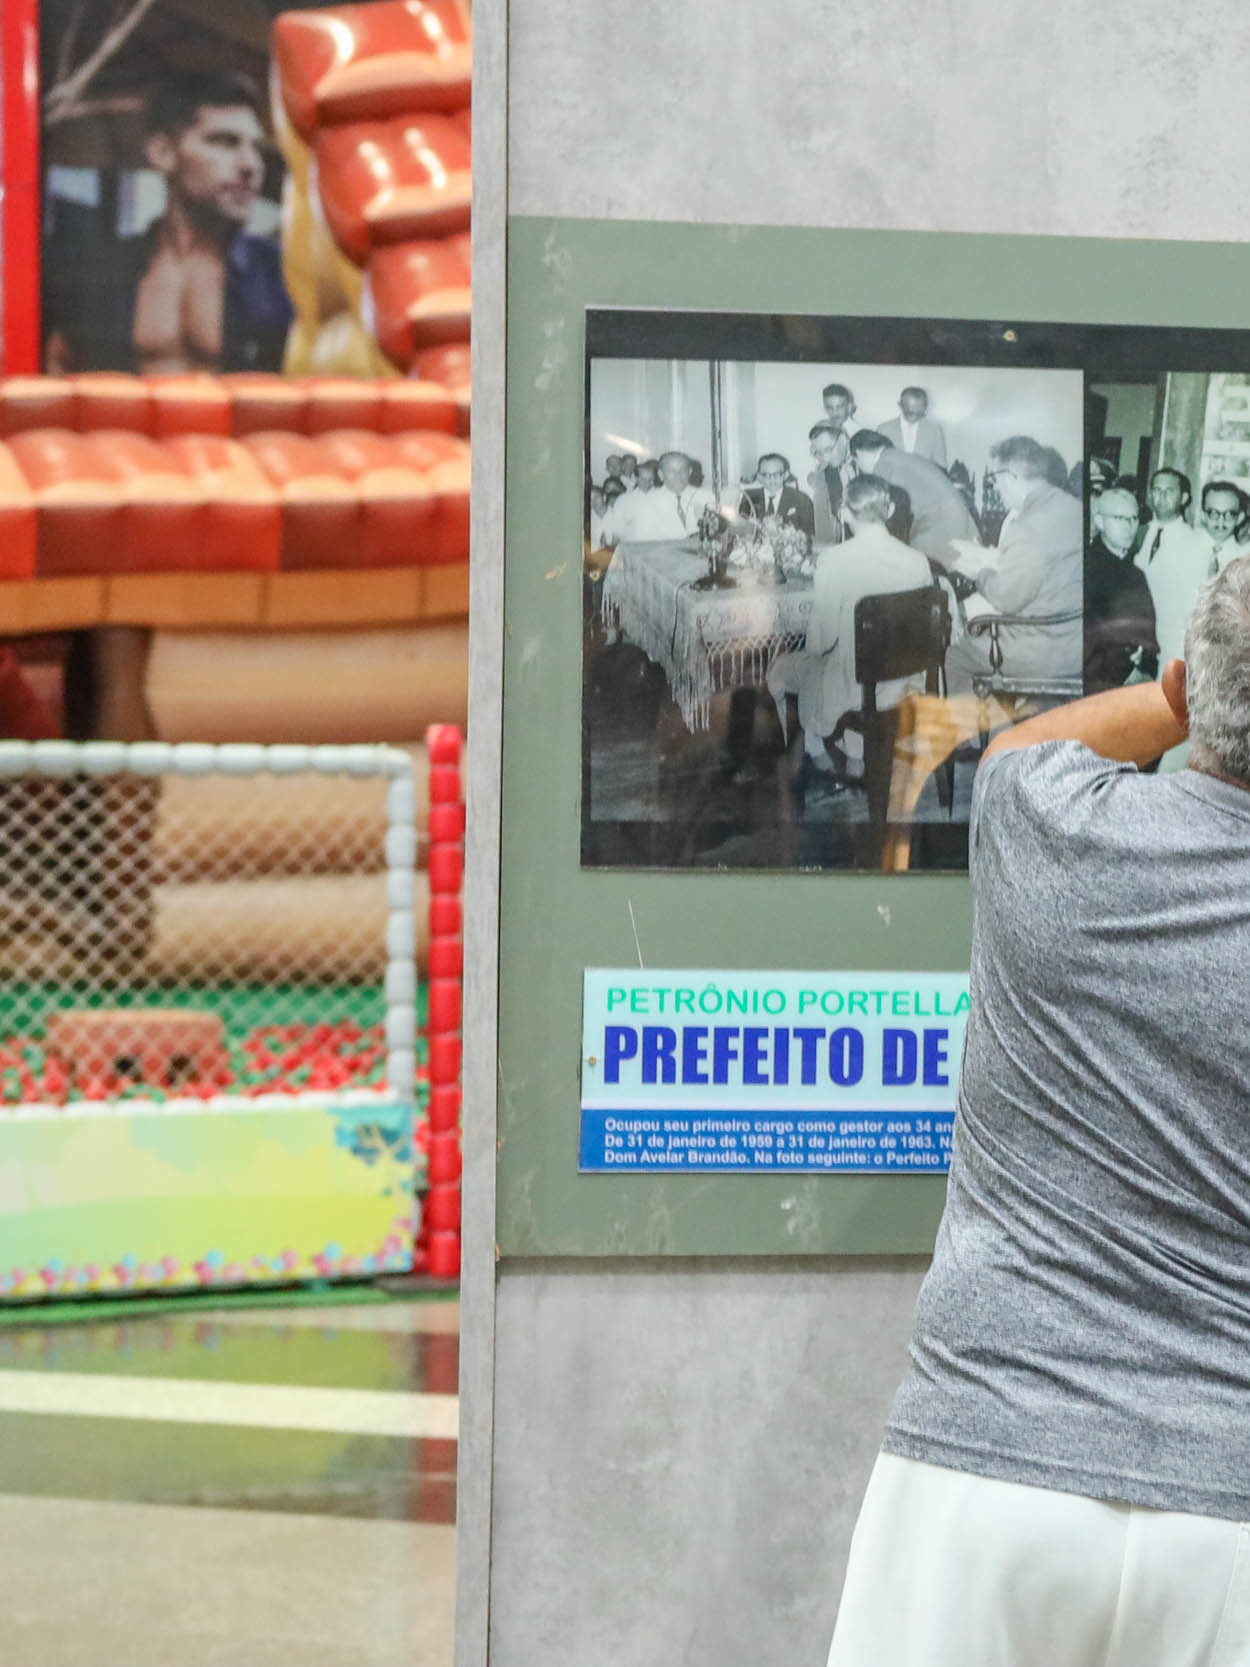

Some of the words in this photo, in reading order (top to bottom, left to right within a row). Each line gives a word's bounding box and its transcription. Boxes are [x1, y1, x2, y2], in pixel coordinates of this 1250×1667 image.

[607, 981, 787, 1015] PETRÔNIO
[798, 989, 971, 1017] PORTELLA
[604, 1025, 864, 1087] PREFEITO
[881, 1027, 949, 1087] DE
[605, 1117, 660, 1133] Ocupou
[663, 1119, 689, 1132] seu
[692, 1117, 751, 1134] primeiro
[754, 1120, 793, 1135] cargo
[797, 1121, 836, 1133] como
[839, 1119, 883, 1135] gestor
[886, 1121, 912, 1133] aos
[915, 1119, 932, 1133] 34
[935, 1121, 954, 1133] an
[605, 1134, 624, 1147] De
[627, 1134, 643, 1148] 31
[647, 1134, 665, 1148] de
[668, 1134, 716, 1150] janeiro
[719, 1135, 737, 1148] de
[776, 1138, 785, 1148] a
[788, 1135, 804, 1148] 31
[808, 1135, 825, 1148] de
[828, 1134, 876, 1150] janeiro
[879, 1135, 897, 1149] de
[901, 1136, 936, 1149] 1963.
[940, 1136, 954, 1149] N
[605, 1150, 637, 1163] Dom
[640, 1150, 684, 1163] Avelar
[688, 1150, 750, 1164] Brandão.
[755, 1151, 773, 1164] Na
[777, 1151, 804, 1164] foto
[807, 1151, 871, 1167] seguinte:
[874, 1154, 883, 1165] o
[887, 1152, 940, 1165] Perfeito
